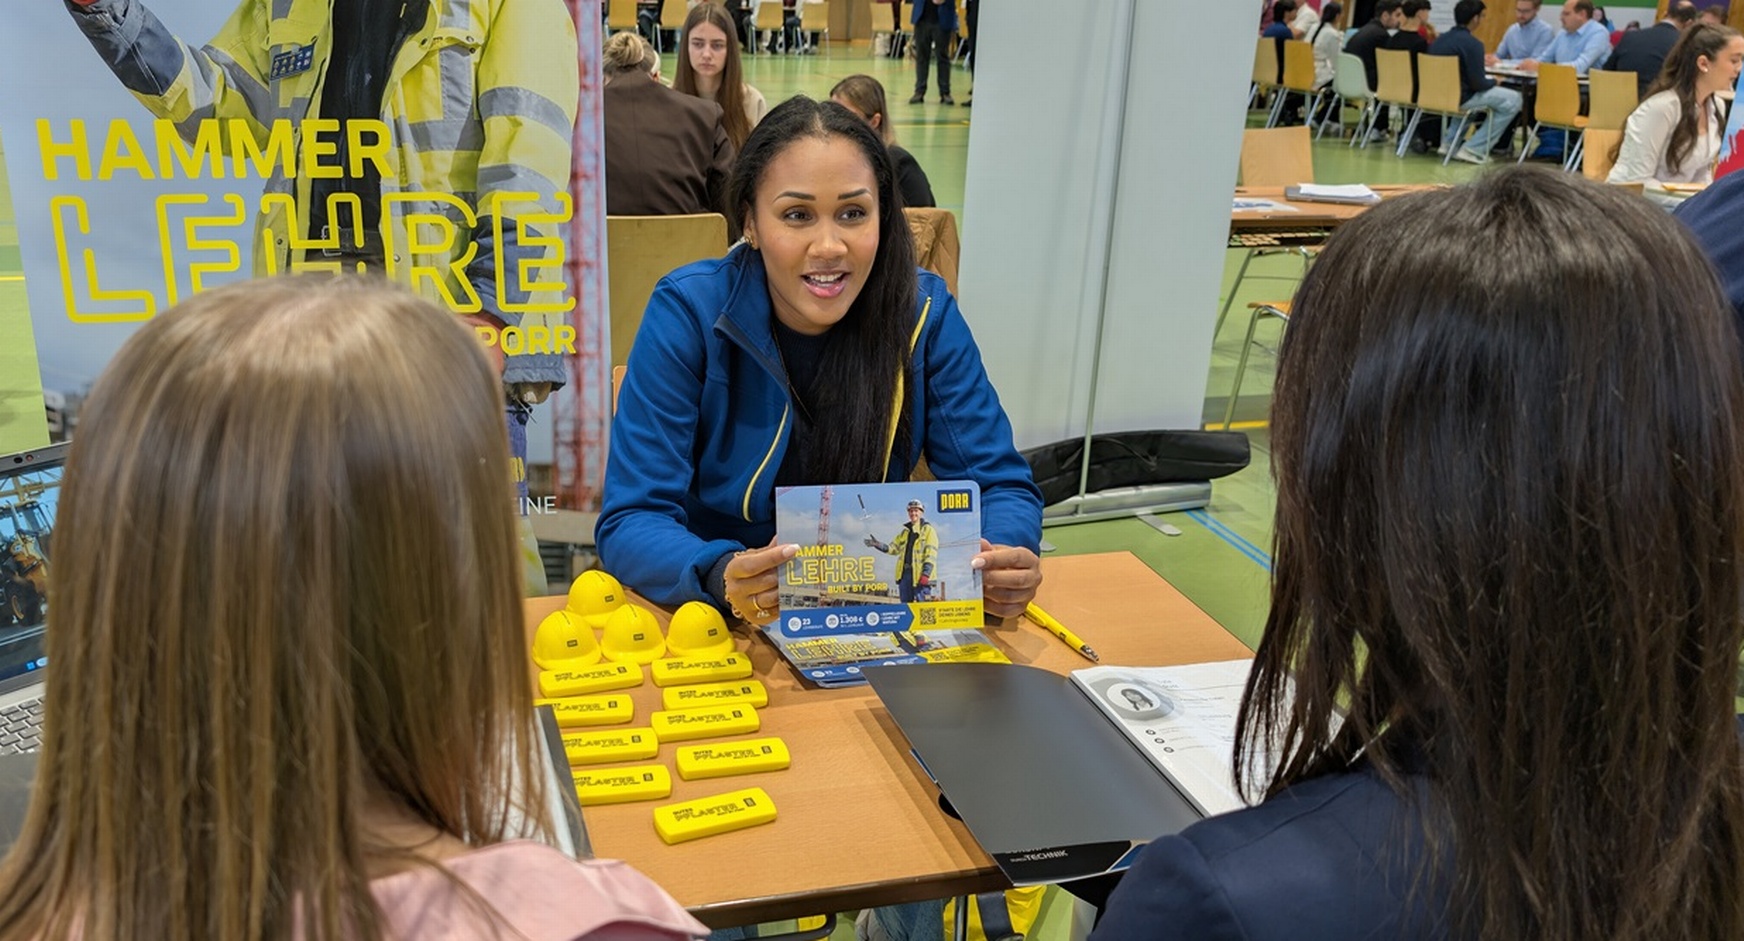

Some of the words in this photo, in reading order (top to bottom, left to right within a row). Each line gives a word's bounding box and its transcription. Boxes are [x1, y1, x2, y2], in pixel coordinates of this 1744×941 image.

[35, 118, 395, 181] HAMMER
[51, 191, 577, 323] LEHRE
[474, 325, 577, 357] PORR
[514, 496, 558, 515] INE
[941, 493, 969, 511] PORR
[794, 544, 844, 557] AMMER
[786, 556, 876, 586] LEHRE
[827, 585, 851, 594] BUILT
[852, 584, 863, 592] BY
[865, 583, 888, 592] PORR
[802, 618, 811, 626] 23
[1024, 850, 1069, 861] TECHNIK
